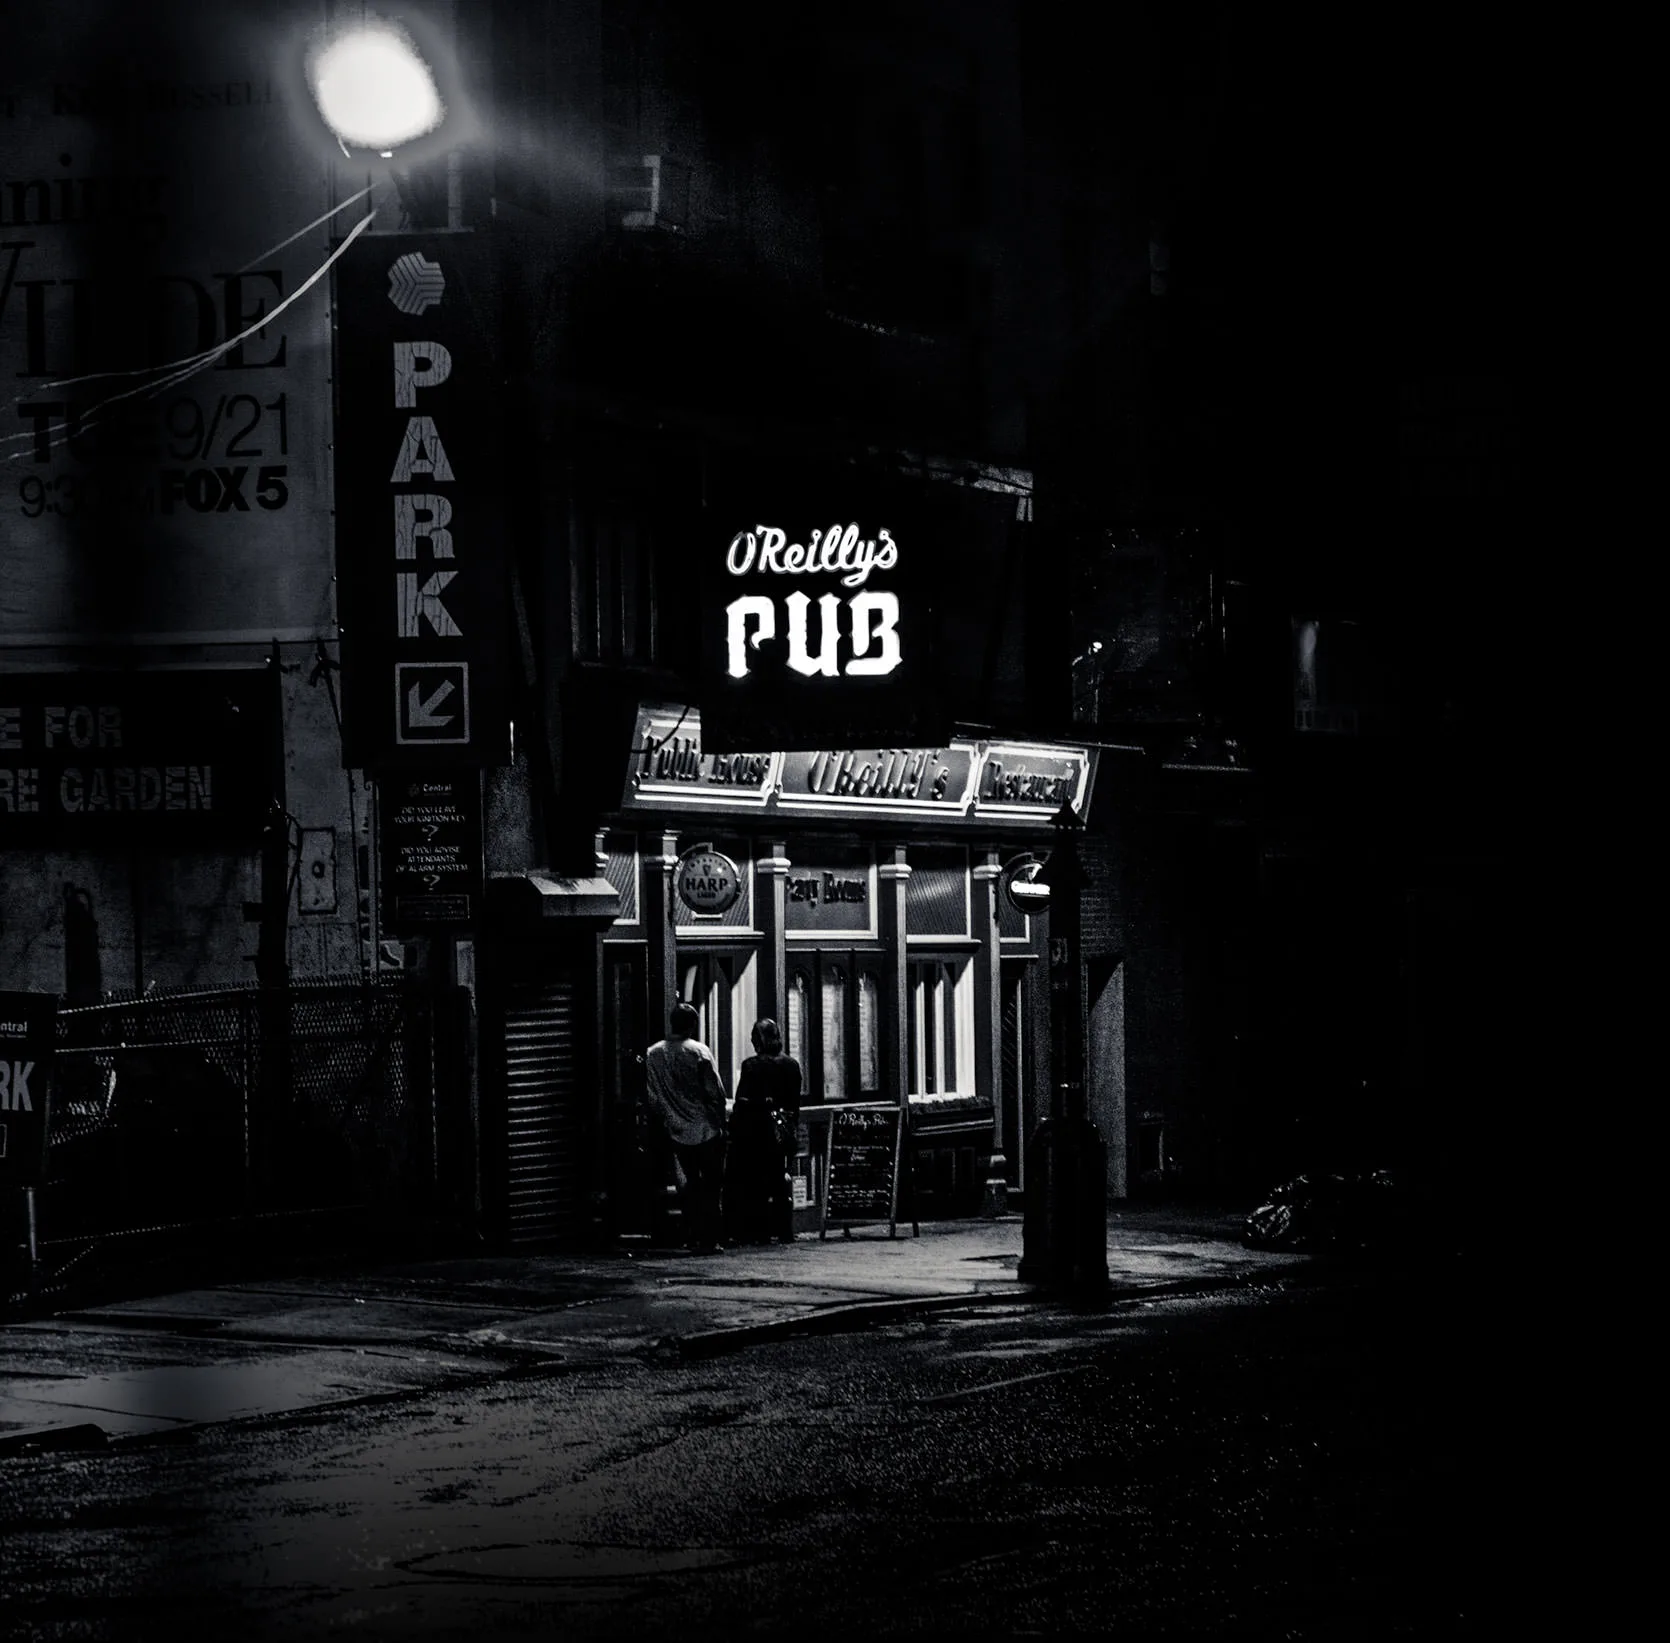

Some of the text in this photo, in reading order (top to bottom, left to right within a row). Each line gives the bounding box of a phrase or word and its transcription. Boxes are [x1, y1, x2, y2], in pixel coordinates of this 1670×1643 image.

[165, 392, 288, 461] 9/21
[158, 465, 250, 516] FOX
[256, 465, 289, 511] 5
[390, 341, 463, 637] PARK
[725, 590, 903, 679] PUB
[43, 705, 125, 748] FOR
[59, 764, 214, 813] GARDEN
[685, 878, 728, 892] HARP
